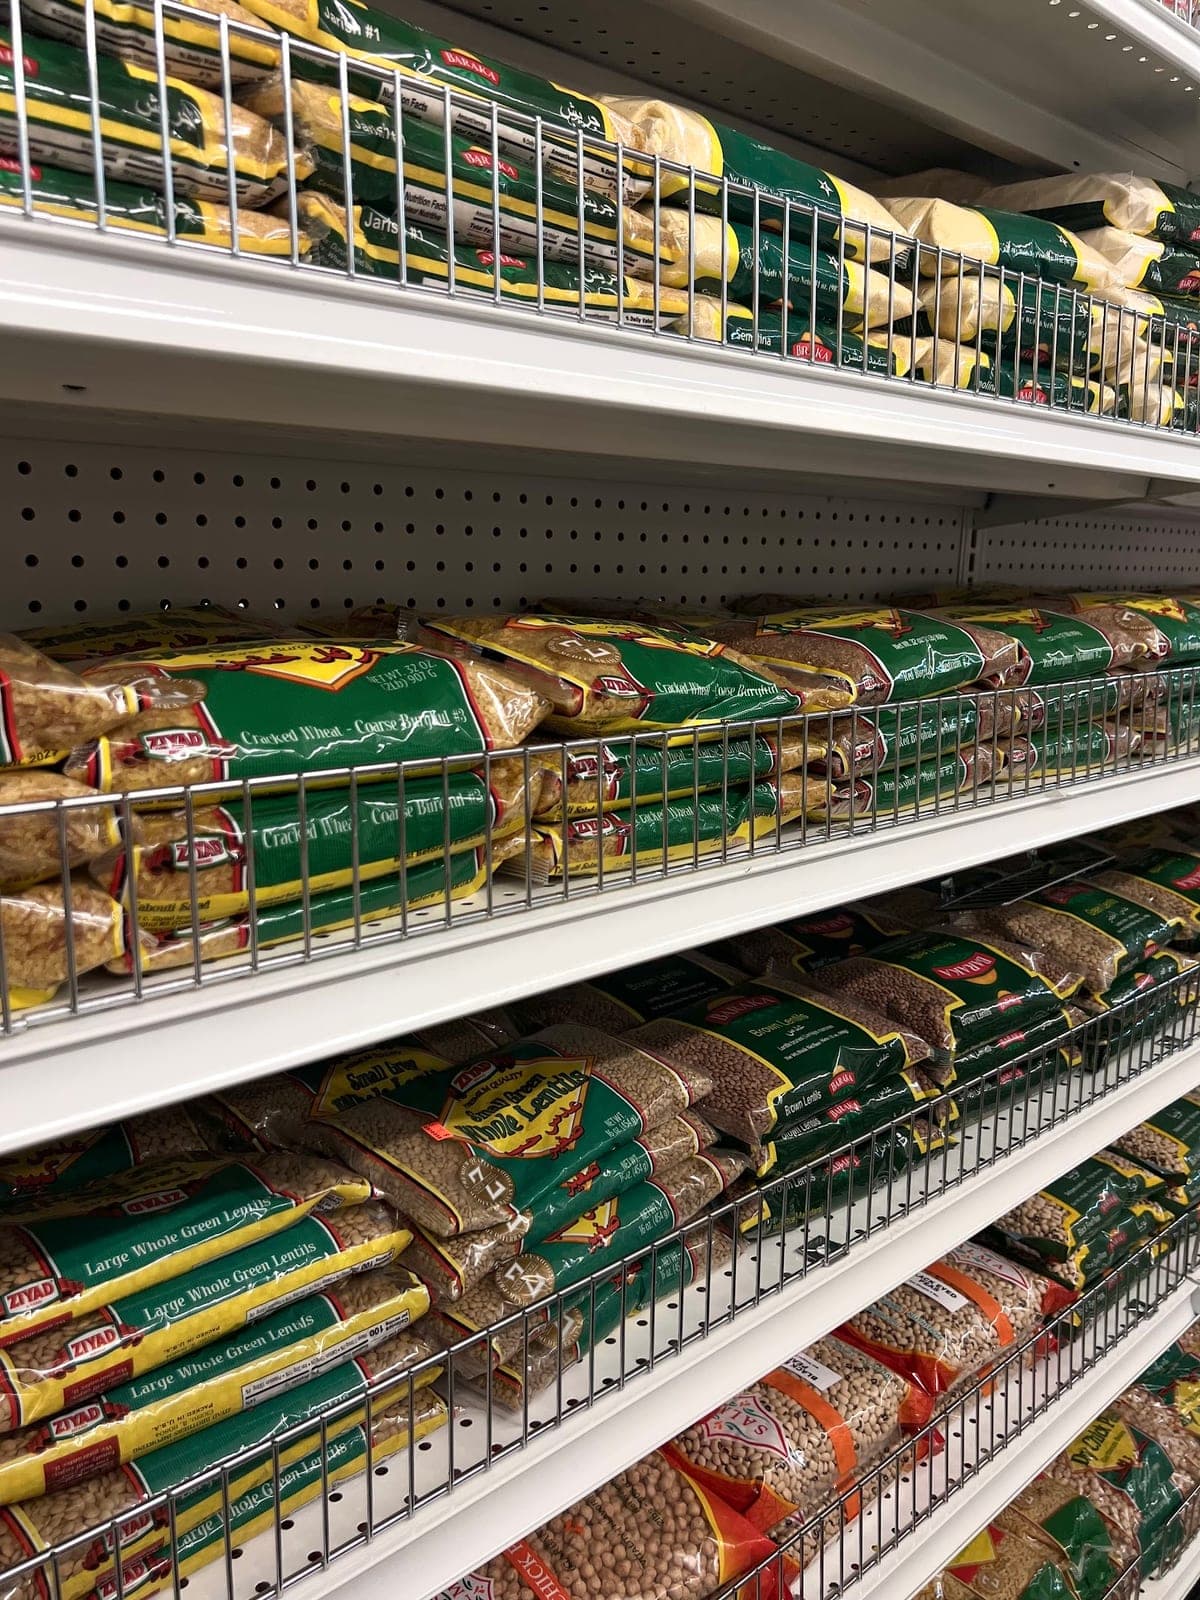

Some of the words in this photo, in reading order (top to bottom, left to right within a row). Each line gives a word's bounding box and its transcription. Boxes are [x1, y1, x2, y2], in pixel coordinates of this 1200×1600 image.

[364, 24, 381, 42] #1
[446, 51, 498, 83] BARAKA
[364, 212, 399, 234] Jaris
[731, 327, 772, 346] Semlina
[404, 663, 417, 675] 32
[407, 672, 427, 684] 907
[240, 729, 298, 746] Cracked
[299, 725, 342, 742] Wheat
[354, 718, 398, 736] Coarse
[453, 707, 467, 722] #3
[749, 1020, 781, 1037] Brown
[779, 1013, 809, 1028] Lentils
[455, 1062, 492, 1089] ZIYAD
[784, 1101, 803, 1117] Brown
[802, 1089, 822, 1108] Lentils
[84, 1250, 130, 1277] Large
[131, 1231, 179, 1258] Whole
[180, 1215, 222, 1239] Green
[223, 1196, 273, 1223] Lentils
[8, 1280, 55, 1310] ZIYAD
[143, 1296, 185, 1322] Large
[187, 1276, 232, 1303] Whole
[232, 1261, 271, 1284] Green
[271, 1242, 317, 1268] Lentils
[71, 1328, 117, 1358] ZIYAD
[369, 1324, 385, 1338] 100
[130, 1373, 175, 1399] Large
[177, 1353, 225, 1380] Whole
[226, 1337, 267, 1360] Green
[267, 1313, 315, 1341] Lentils
[53, 1405, 101, 1434] ZIYAD
[187, 1402, 214, 1418] PACKED
[152, 1419, 176, 1432] U.S.A.
